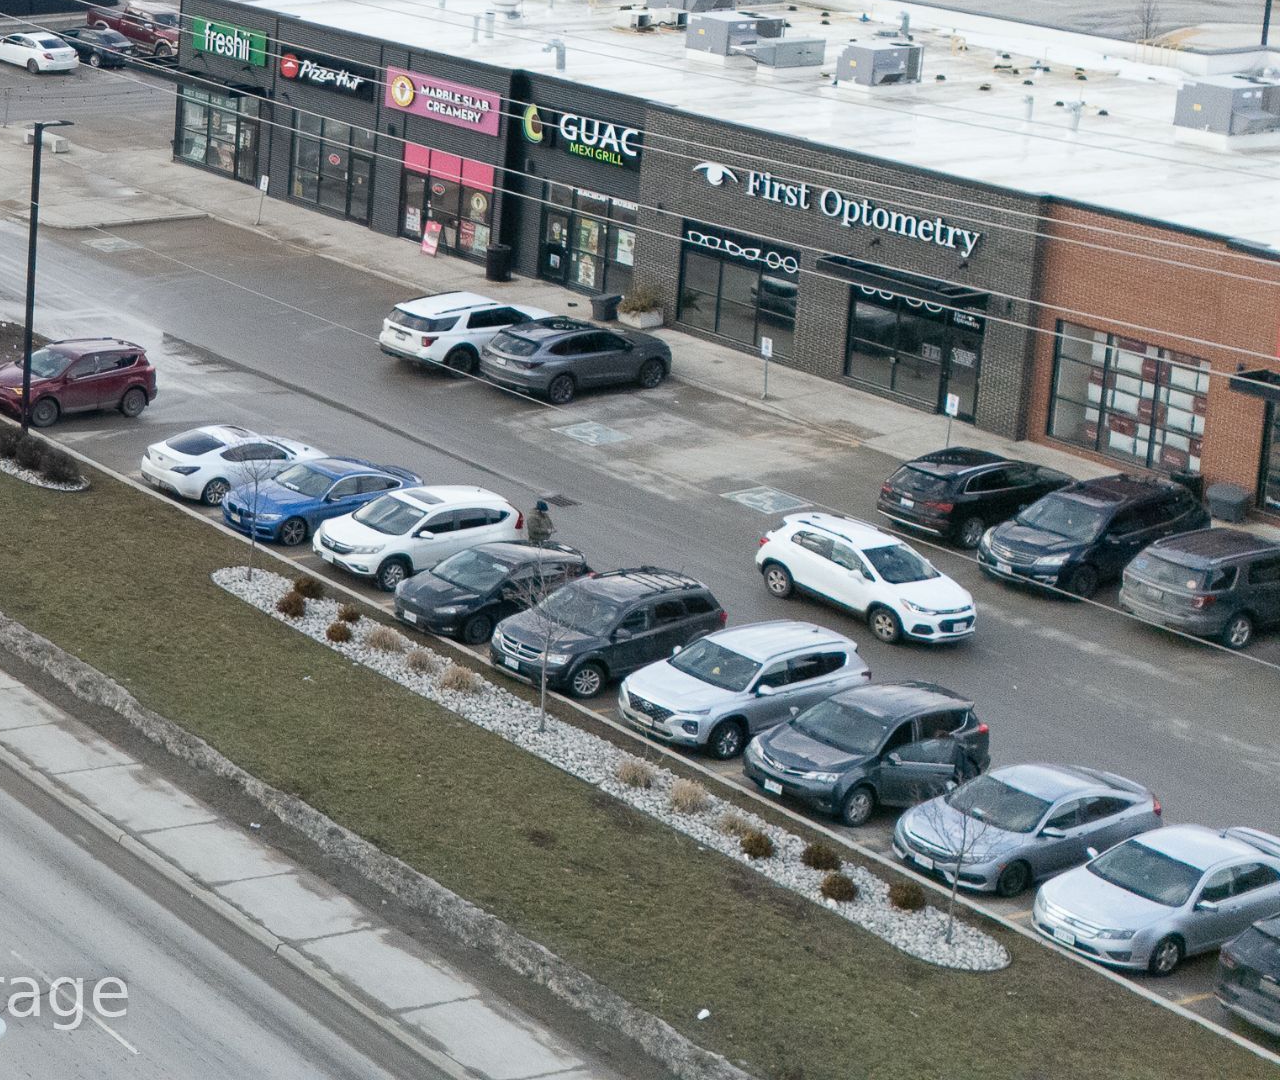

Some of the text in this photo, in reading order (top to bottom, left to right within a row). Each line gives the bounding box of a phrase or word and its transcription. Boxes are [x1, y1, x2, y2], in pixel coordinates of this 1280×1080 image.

[203, 23, 251, 61] freshii
[300, 59, 364, 91] Pizza Hut
[420, 85, 490, 111] MARBLE SLAB
[426, 100, 481, 123] CREAMERY
[559, 113, 639, 157] GUAC
[570, 142, 624, 166] MEXI GRILL
[746, 170, 980, 258] First Optometry
